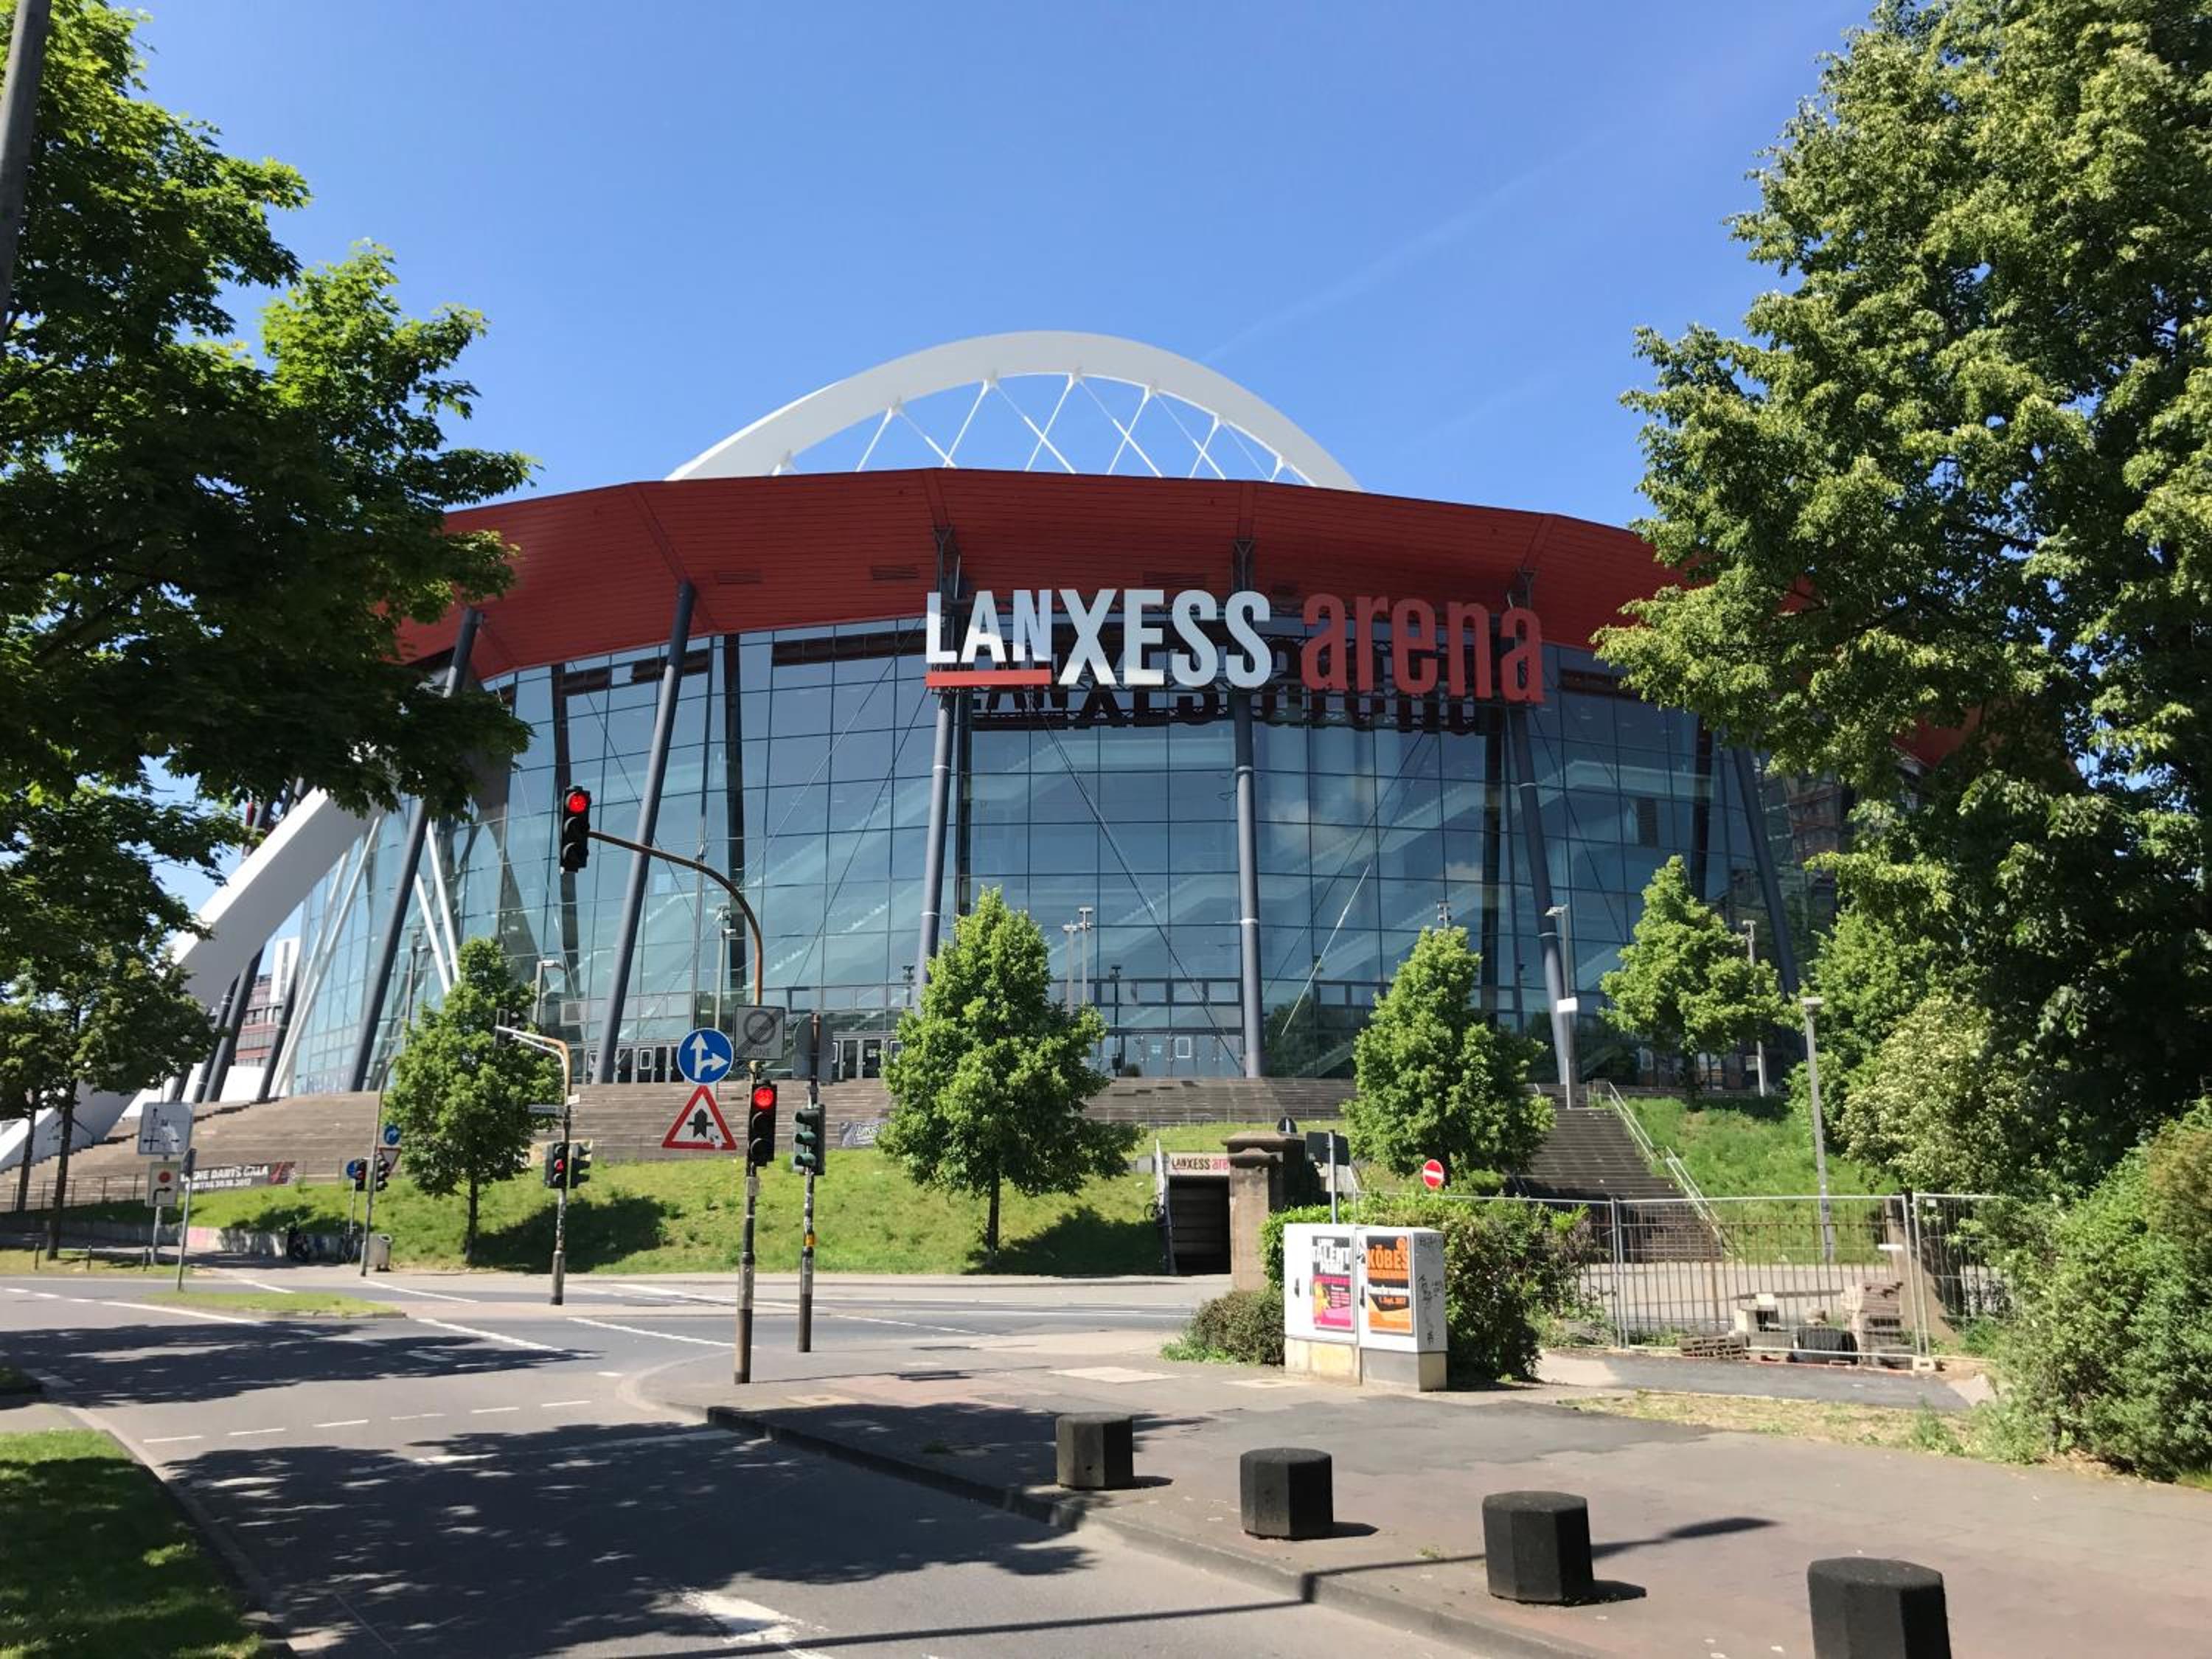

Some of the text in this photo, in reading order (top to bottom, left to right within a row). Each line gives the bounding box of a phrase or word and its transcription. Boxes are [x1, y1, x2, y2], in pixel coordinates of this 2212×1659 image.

[926, 590, 1545, 704] LANXESS arena
[1172, 1157, 1228, 1170] LANXESS are
[1366, 1244, 1408, 1270] KÖBES
